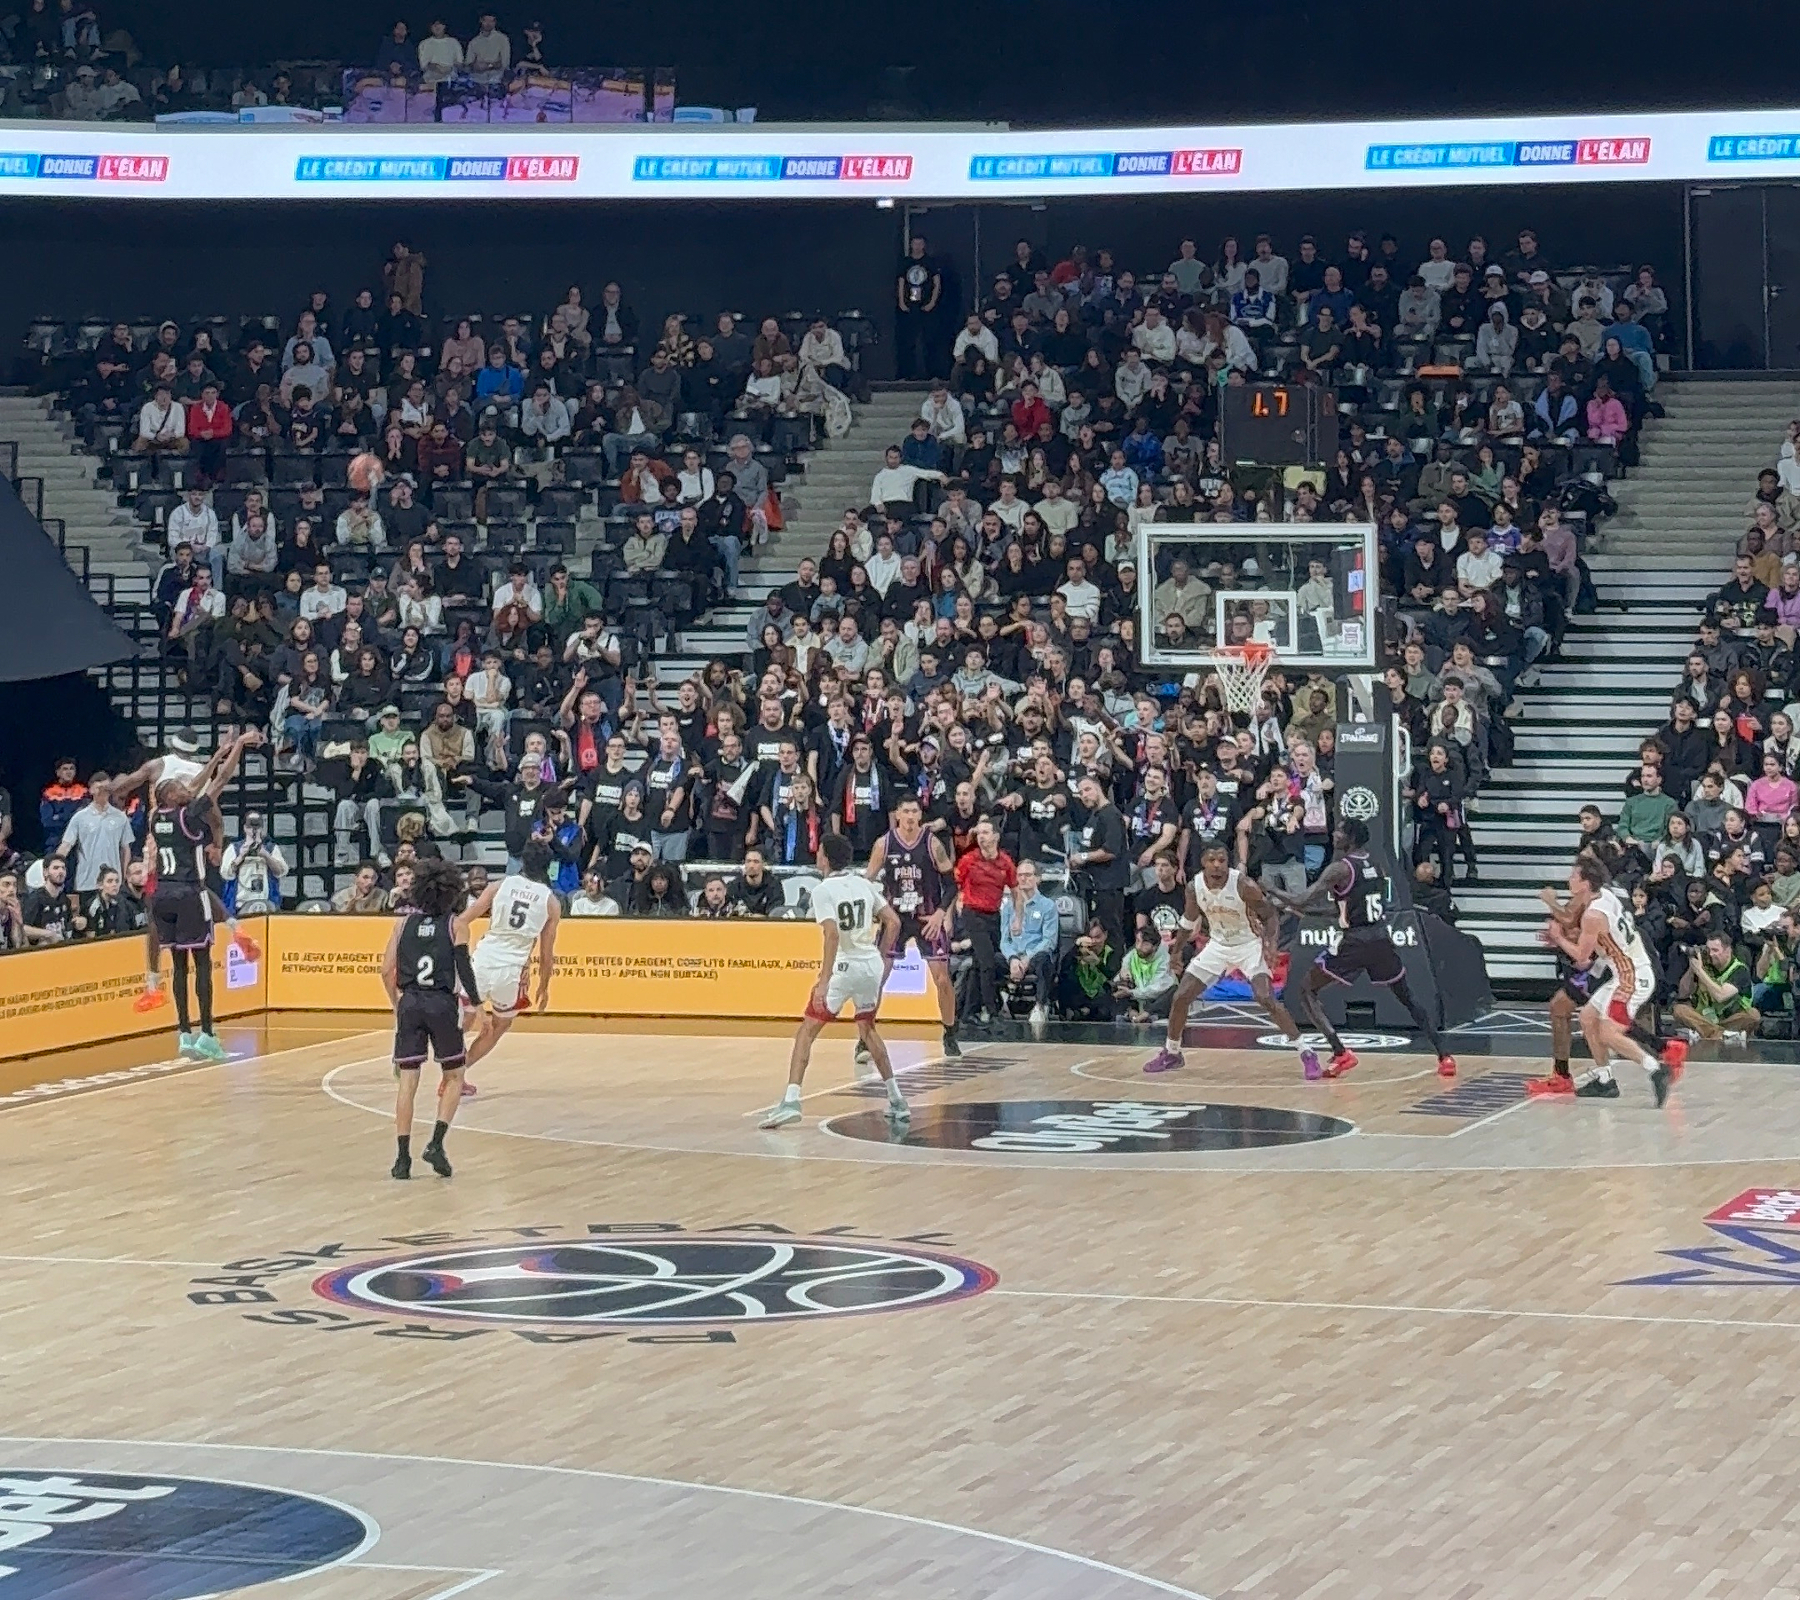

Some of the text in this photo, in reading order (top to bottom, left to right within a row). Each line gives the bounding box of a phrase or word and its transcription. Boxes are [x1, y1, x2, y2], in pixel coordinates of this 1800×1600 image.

[1372, 149, 1390, 165] LE
[1519, 144, 1571, 161] DONNE
[1582, 140, 1645, 160] L'ÉLAN
[1714, 139, 1732, 156] LE
[43, 157, 93, 175] DONNE
[104, 156, 163, 177] L'ÉLAN
[302, 160, 321, 176] LE
[450, 160, 501, 176] DONNE
[512, 158, 574, 177] L'ÉLAN
[640, 160, 658, 176] LE
[786, 160, 836, 176] DONNE
[847, 158, 908, 176] L'ÉLAN
[975, 160, 992, 176] LE
[1118, 155, 1167, 172] DONNE
[1177, 151, 1237, 172] L'ÉLAN
[159, 846, 177, 875] 11
[508, 900, 529, 930] 5
[837, 898, 866, 931] 97
[1365, 893, 1383, 923] 15
[416, 955, 435, 986] 2
[187, 1222, 958, 1307] BASKETBALL
[244, 1306, 737, 1345] PARIS
